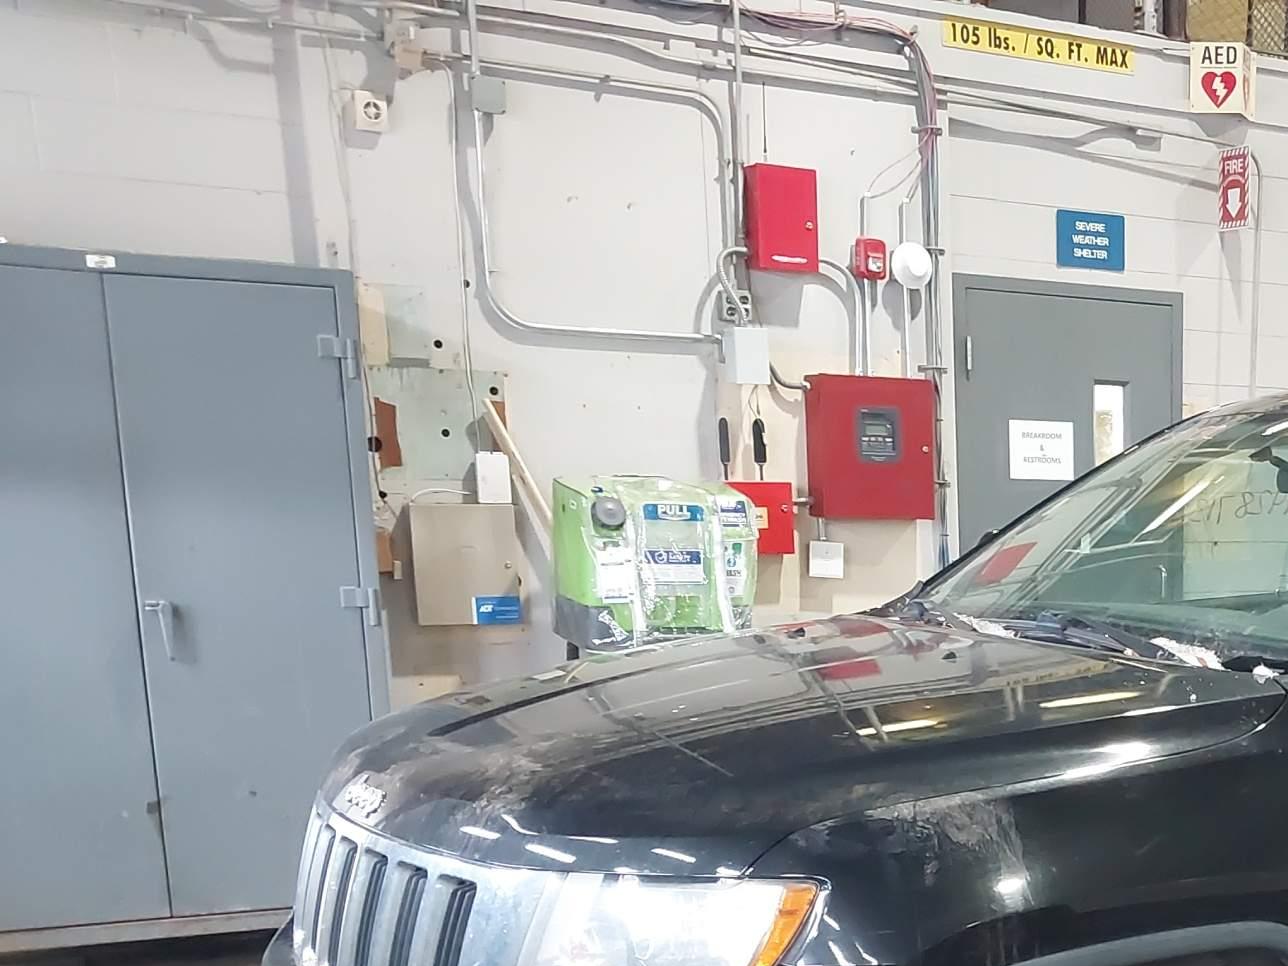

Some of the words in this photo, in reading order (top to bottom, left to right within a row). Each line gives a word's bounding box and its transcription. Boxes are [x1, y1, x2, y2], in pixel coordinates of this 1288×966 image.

[950, 23, 980, 45] 105
[987, 31, 1016, 52] lbs.
[1023, 33, 1030, 54] /
[1036, 38, 1061, 59] SQ.
[1067, 44, 1089, 63] FT.
[1095, 47, 1129, 69] MAX
[1201, 45, 1238, 65] AED
[1224, 158, 1244, 175] FIRE
[1074, 221, 1106, 233] SEVERE
[1071, 234, 1110, 247] WEATHER
[1073, 247, 1108, 260] SHELTER
[1021, 431, 1063, 440] BREAKROOM
[657, 503, 690, 516] PULL
